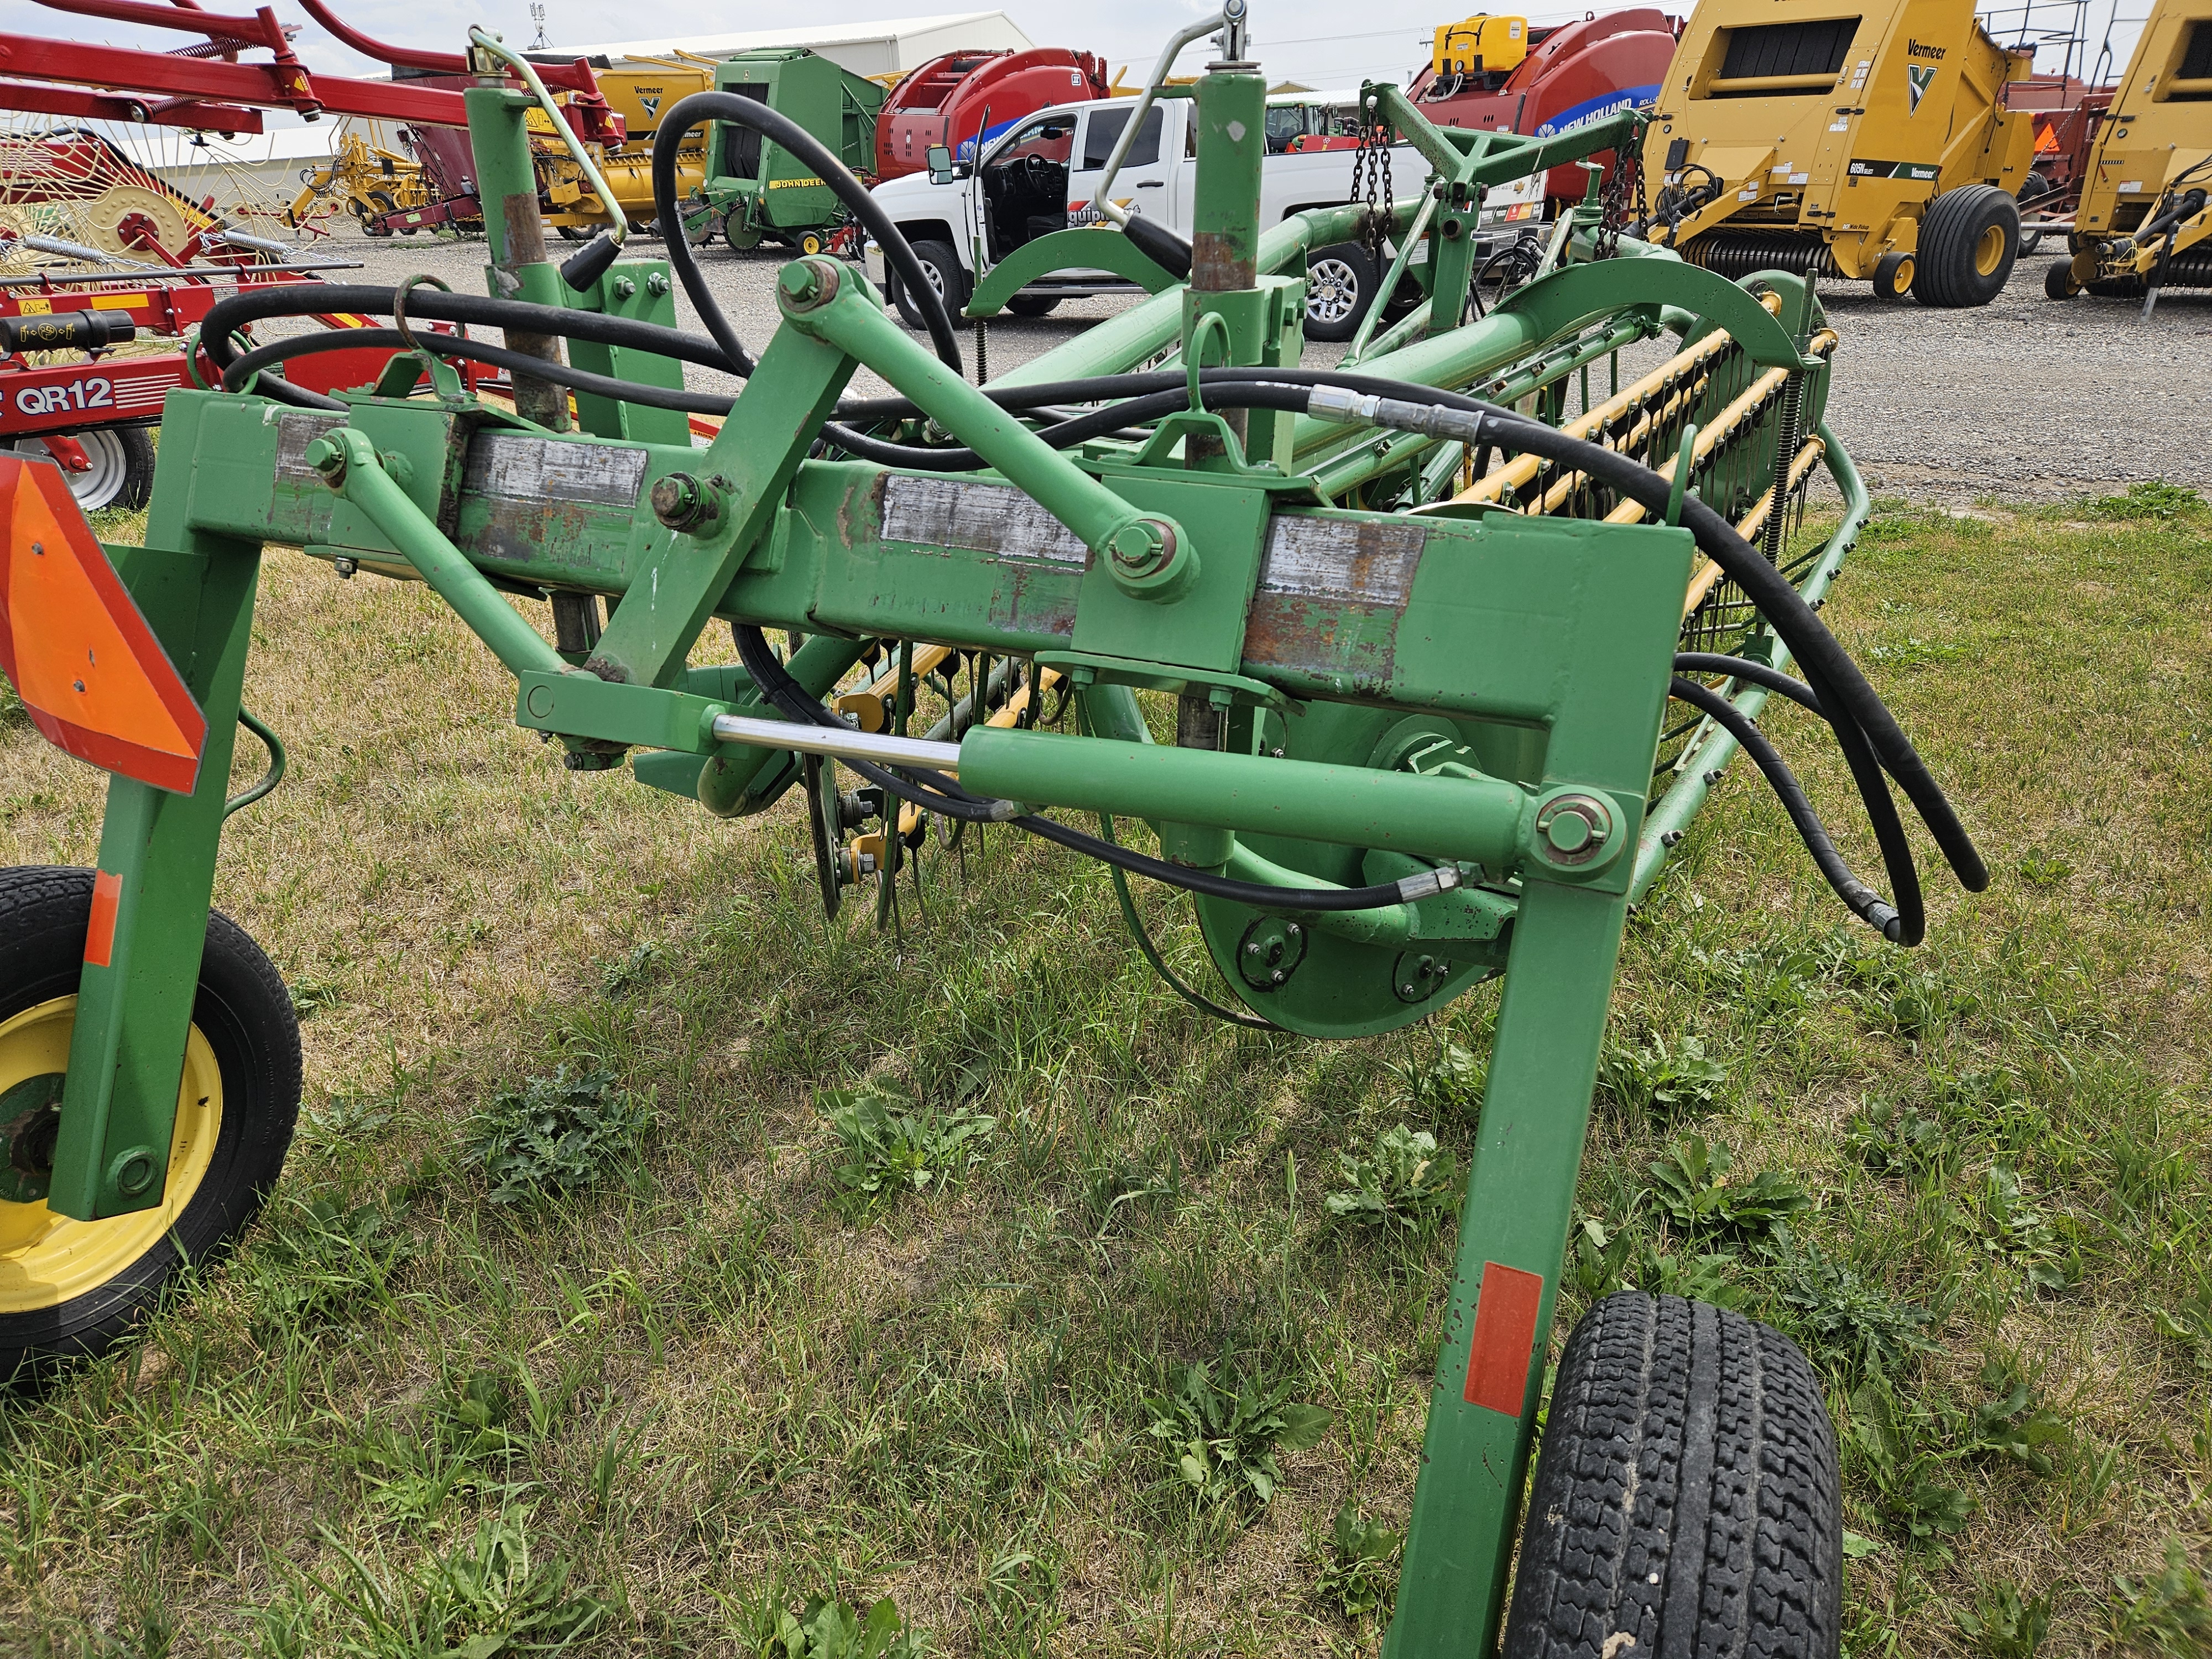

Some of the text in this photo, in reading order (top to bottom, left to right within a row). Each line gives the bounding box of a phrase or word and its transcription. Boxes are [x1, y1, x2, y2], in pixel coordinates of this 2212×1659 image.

[1908, 39, 1947, 60] Vermeer
[634, 86, 664, 94] Vermeer
[1585, 97, 1632, 125] HOLLAND
[1850, 163, 1866, 174] 605N
[1911, 167, 1936, 179] Vermeer
[776, 179, 827, 189] JOHN DEER
[15, 378, 114, 416] QR12
